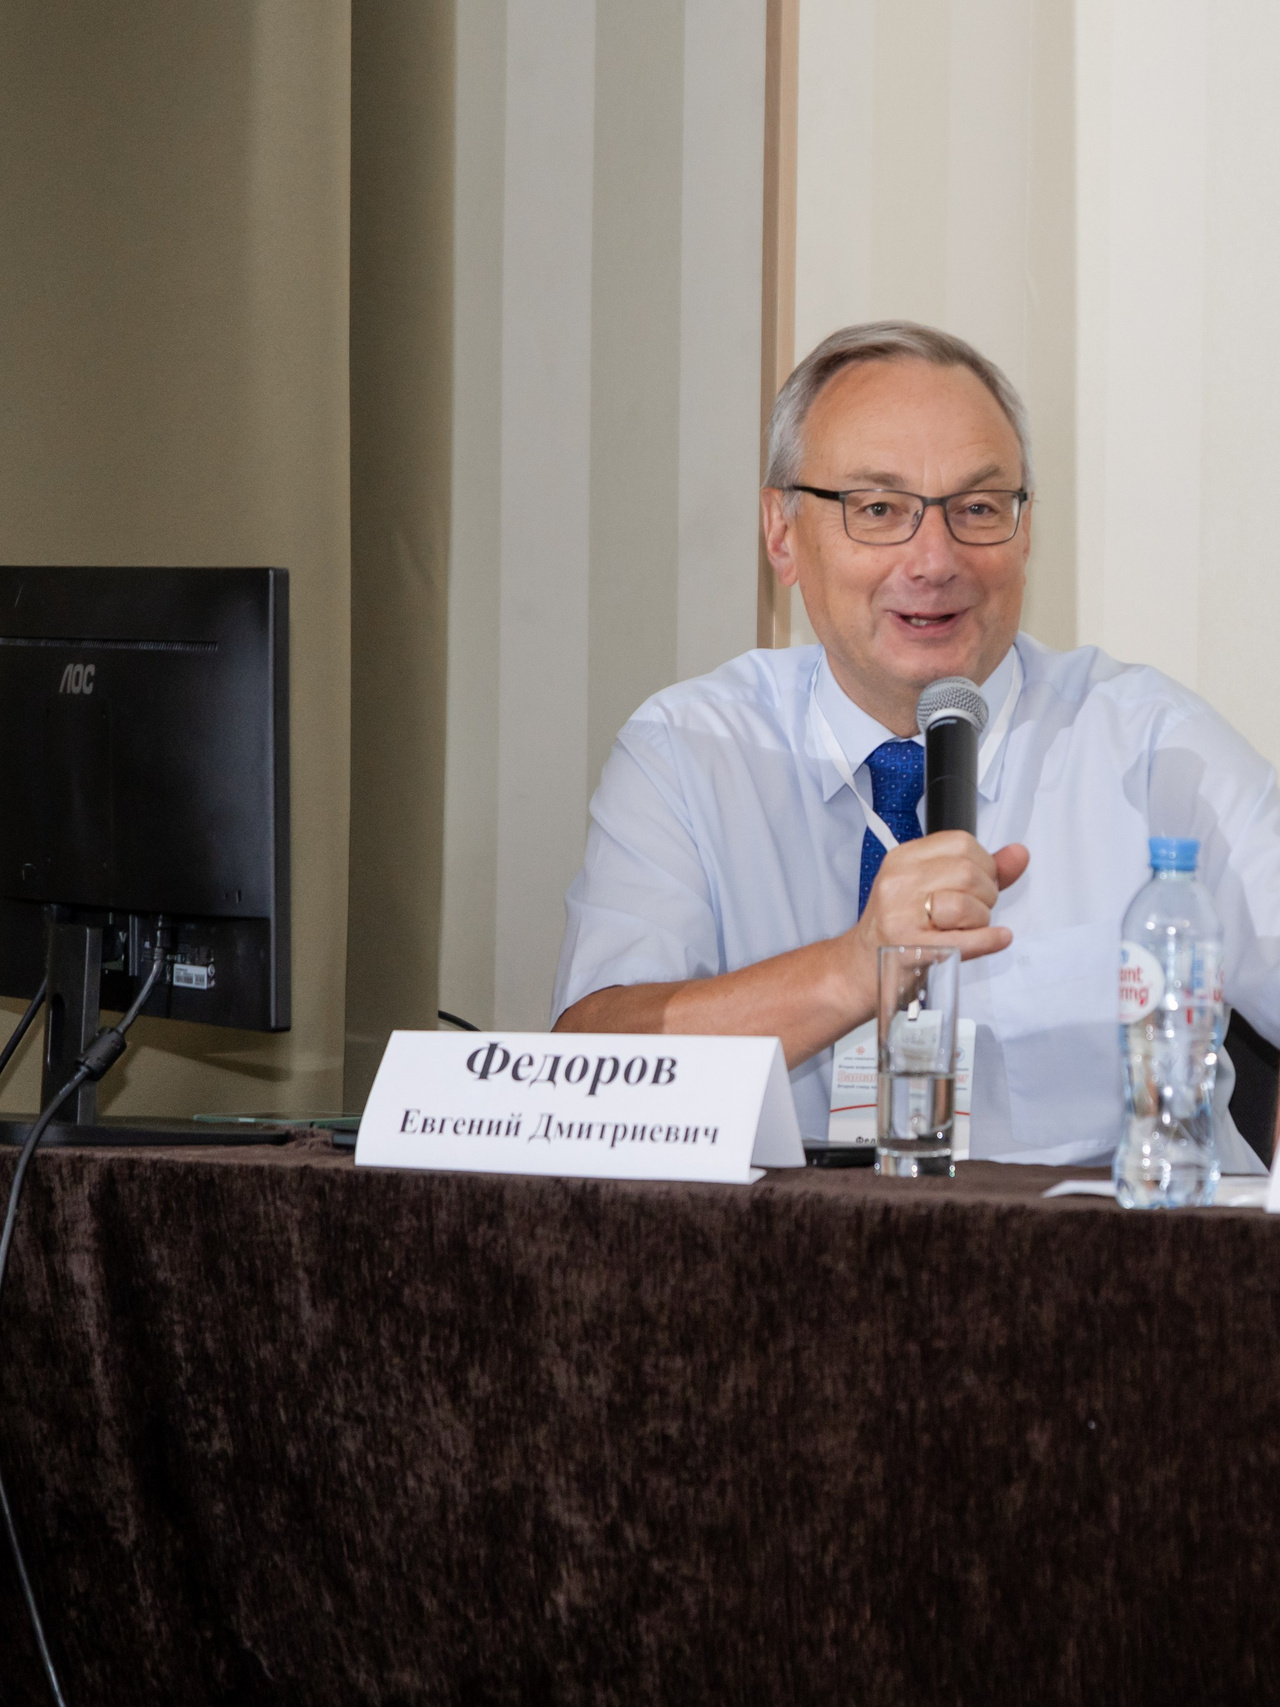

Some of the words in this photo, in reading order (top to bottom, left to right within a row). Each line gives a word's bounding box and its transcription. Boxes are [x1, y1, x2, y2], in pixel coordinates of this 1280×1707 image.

[59, 663, 96, 695] AOC
[465, 1041, 679, 1097] Федоров
[399, 1108, 523, 1138] Евгений
[527, 1113, 720, 1150] Дмитриевич
